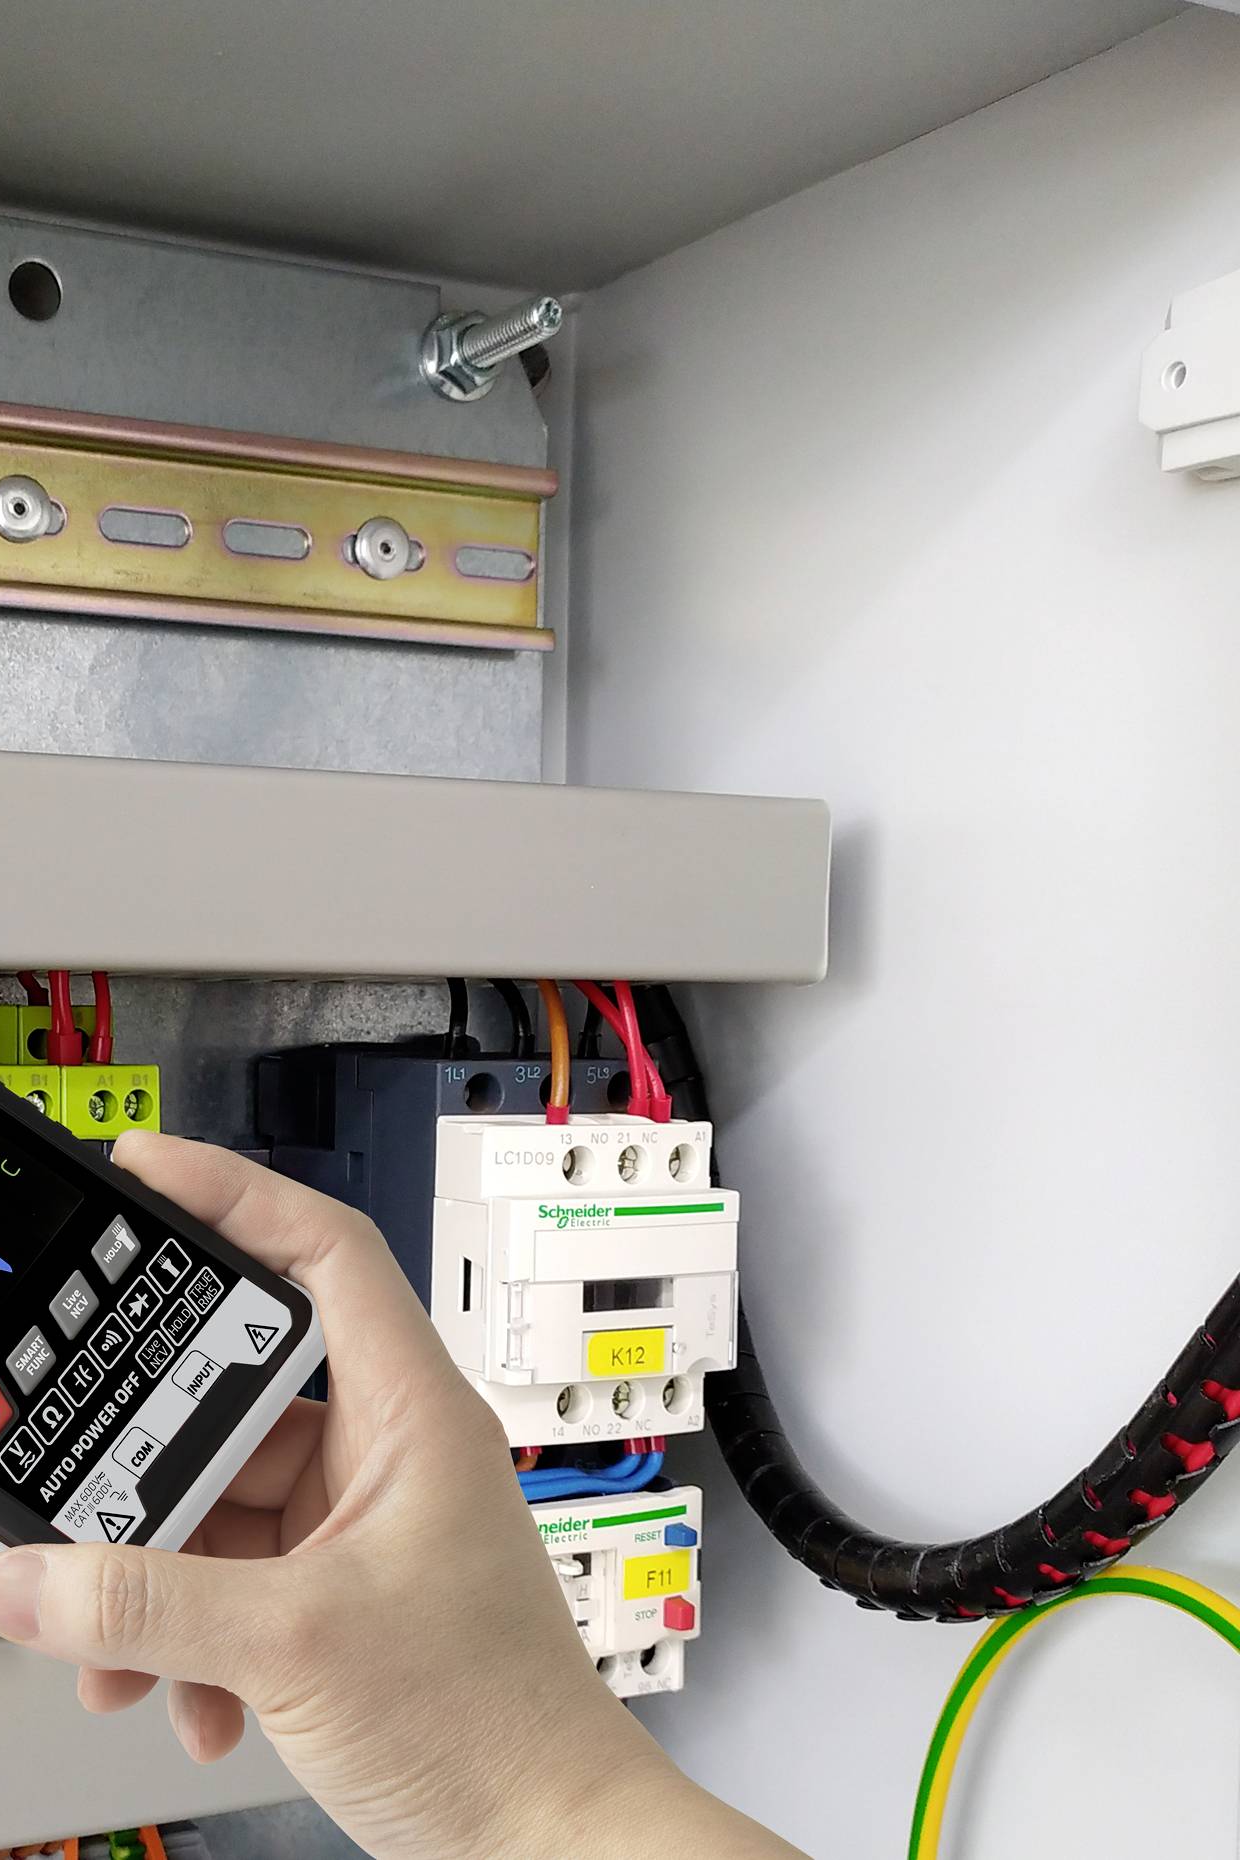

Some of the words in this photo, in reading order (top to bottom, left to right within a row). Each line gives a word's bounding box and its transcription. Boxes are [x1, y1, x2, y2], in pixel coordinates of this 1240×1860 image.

[590, 1133, 609, 1145] NO
[641, 1132, 658, 1143] NC
[495, 1151, 555, 1165] LC1D09
[538, 1204, 612, 1218] Schneider
[570, 1218, 611, 1227] Electric
[103, 1240, 123, 1264] HOLD
[188, 1271, 214, 1298] TRUE
[62, 1289, 82, 1310] Live
[197, 1284, 218, 1309] RMS
[70, 1295, 89, 1320] NCV
[167, 1308, 192, 1336] HOLD
[15, 1335, 45, 1372] SMART
[141, 1339, 161, 1360] Live
[149, 1345, 168, 1370] NCV
[612, 1346, 645, 1367] K12
[26, 1347, 51, 1376] FUNC
[186, 1361, 216, 1396] INPUT
[39, 1456, 76, 1503] AUTO
[70, 1401, 121, 1460] POWER
[114, 1371, 140, 1404] OFF
[582, 1424, 601, 1436] NO
[130, 1441, 155, 1468] COM
[92, 1478, 113, 1505] 600V
[64, 1500, 83, 1522] MAX
[538, 1516, 590, 1534] neider
[544, 1532, 588, 1544] Electric
[634, 1529, 662, 1543] RESET
[646, 1568, 672, 1589] F11
[634, 1608, 658, 1621] STOP
